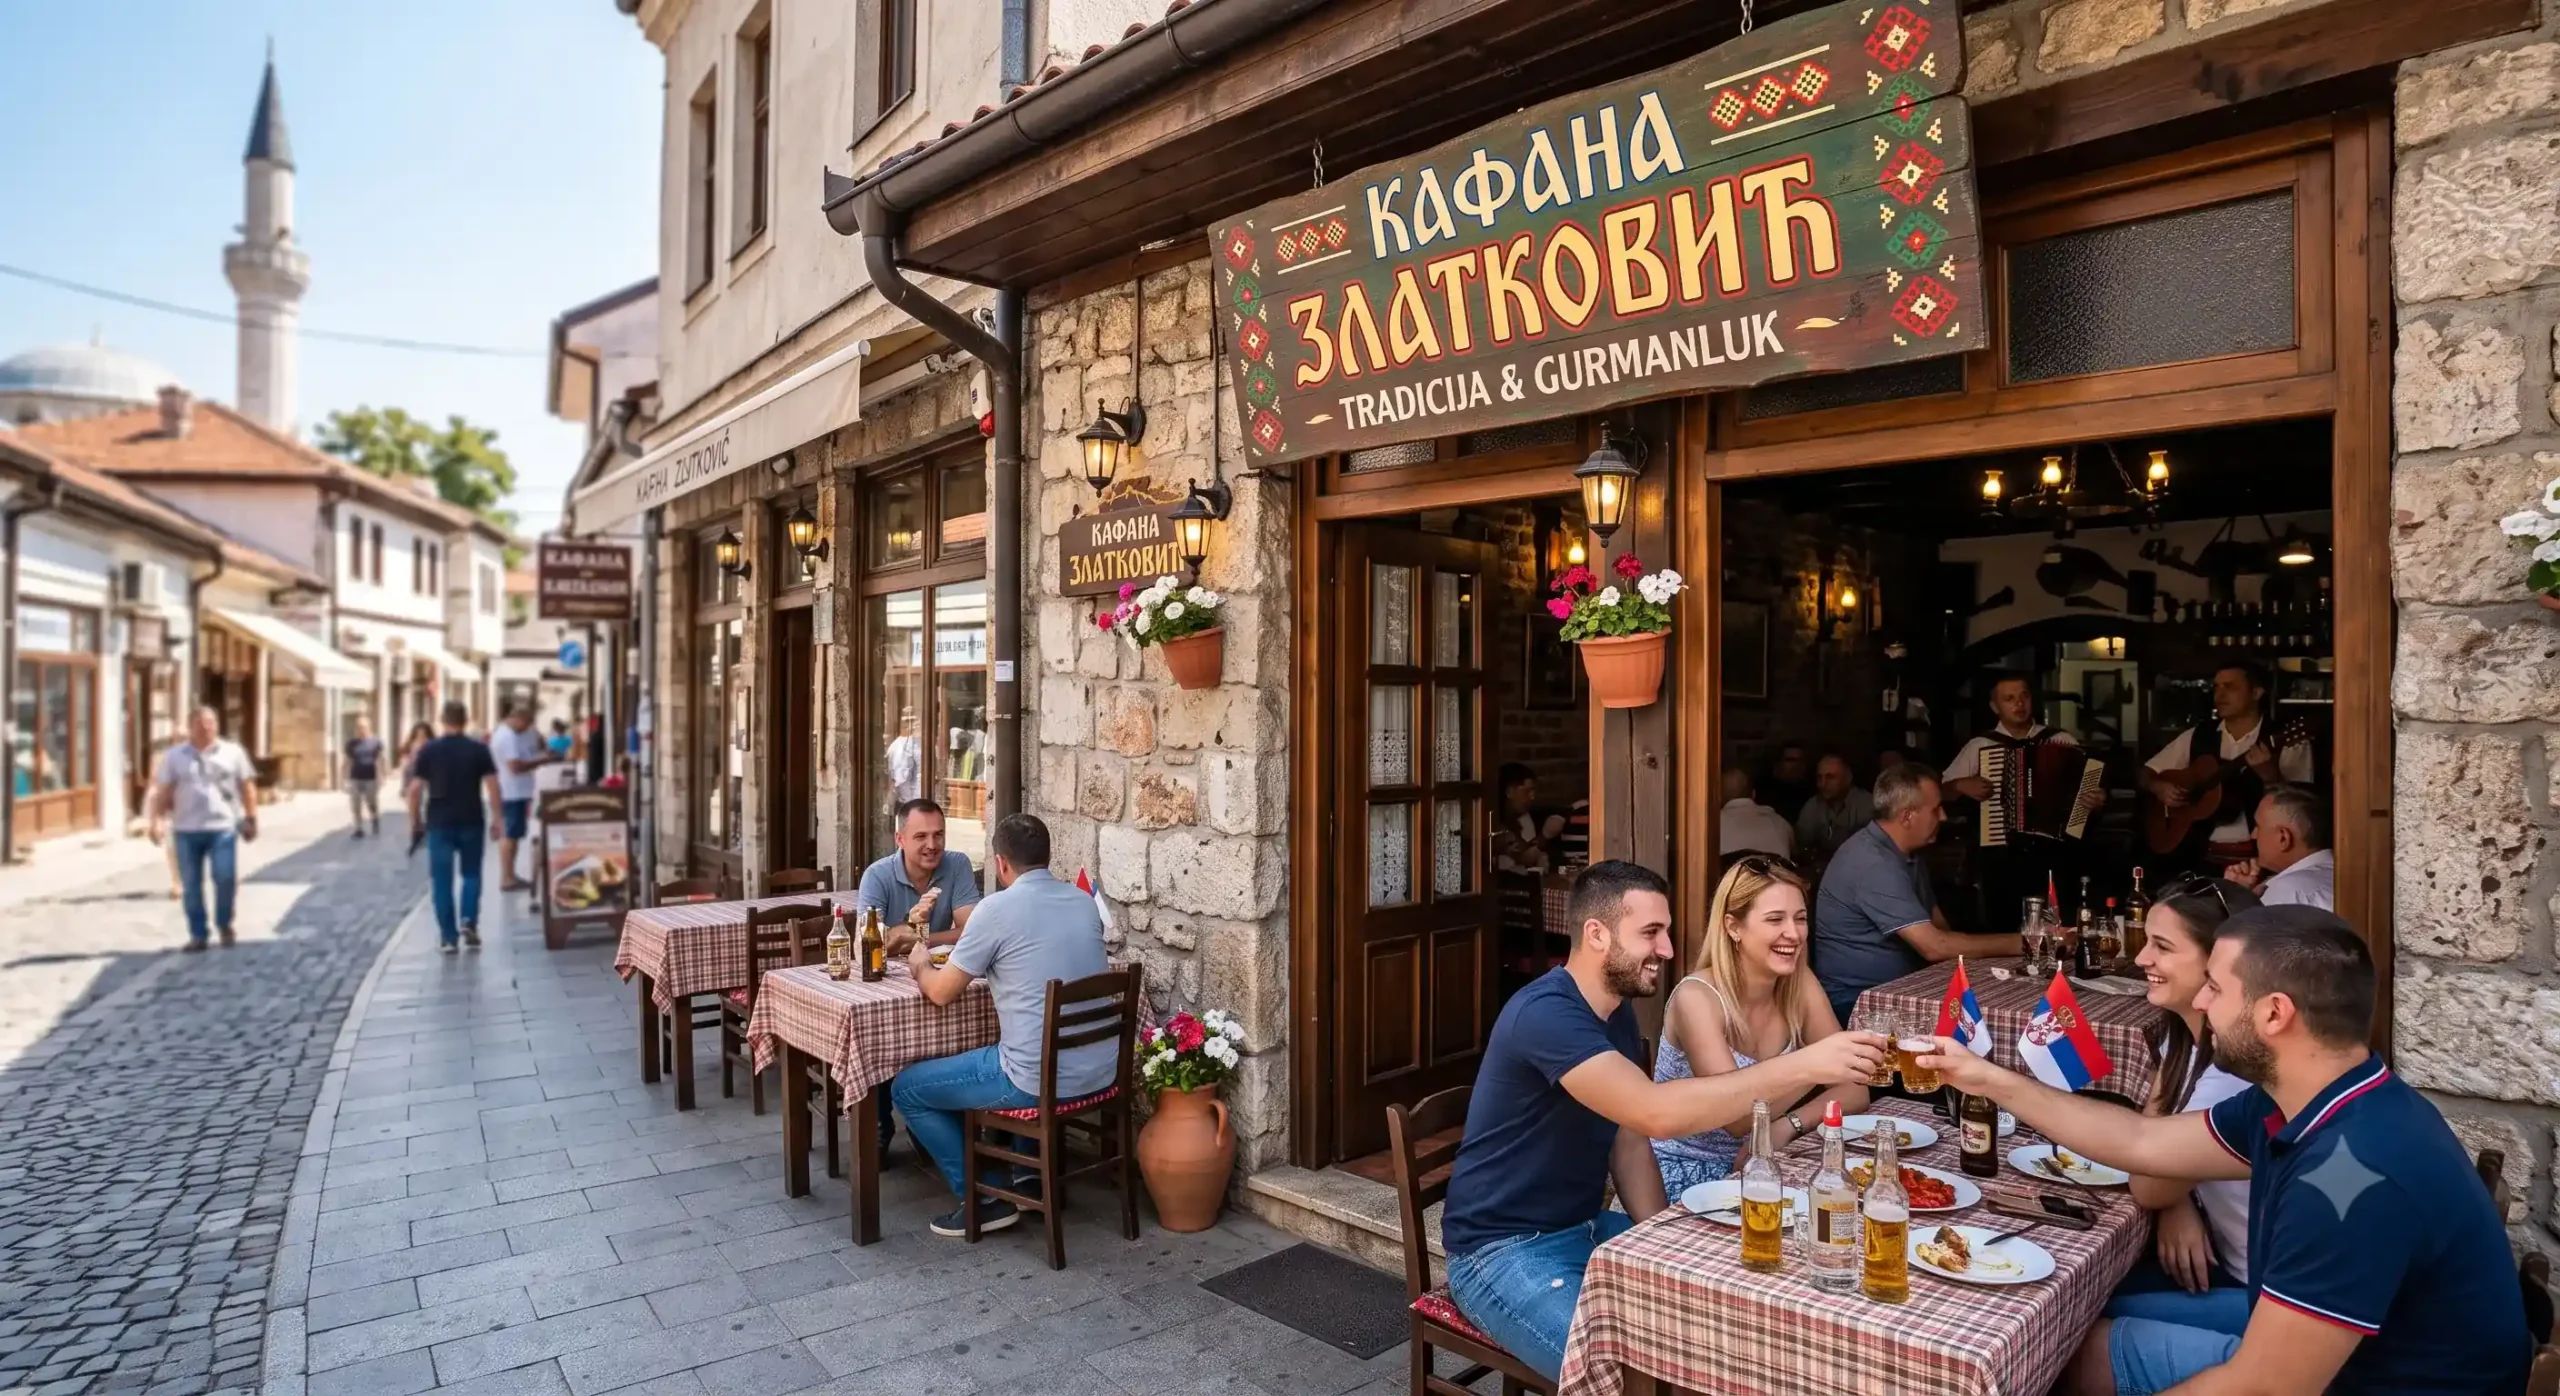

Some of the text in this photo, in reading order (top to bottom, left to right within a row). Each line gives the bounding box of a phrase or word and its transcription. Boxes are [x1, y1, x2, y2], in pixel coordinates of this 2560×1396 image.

[1366, 91, 1685, 260] КАФАНА
[1287, 154, 1842, 388] ЗЛАТКОВИЋ
[1339, 310, 1785, 430] TRADICIJA & GURMANLUK
[1091, 513, 1160, 547] КАФАНА
